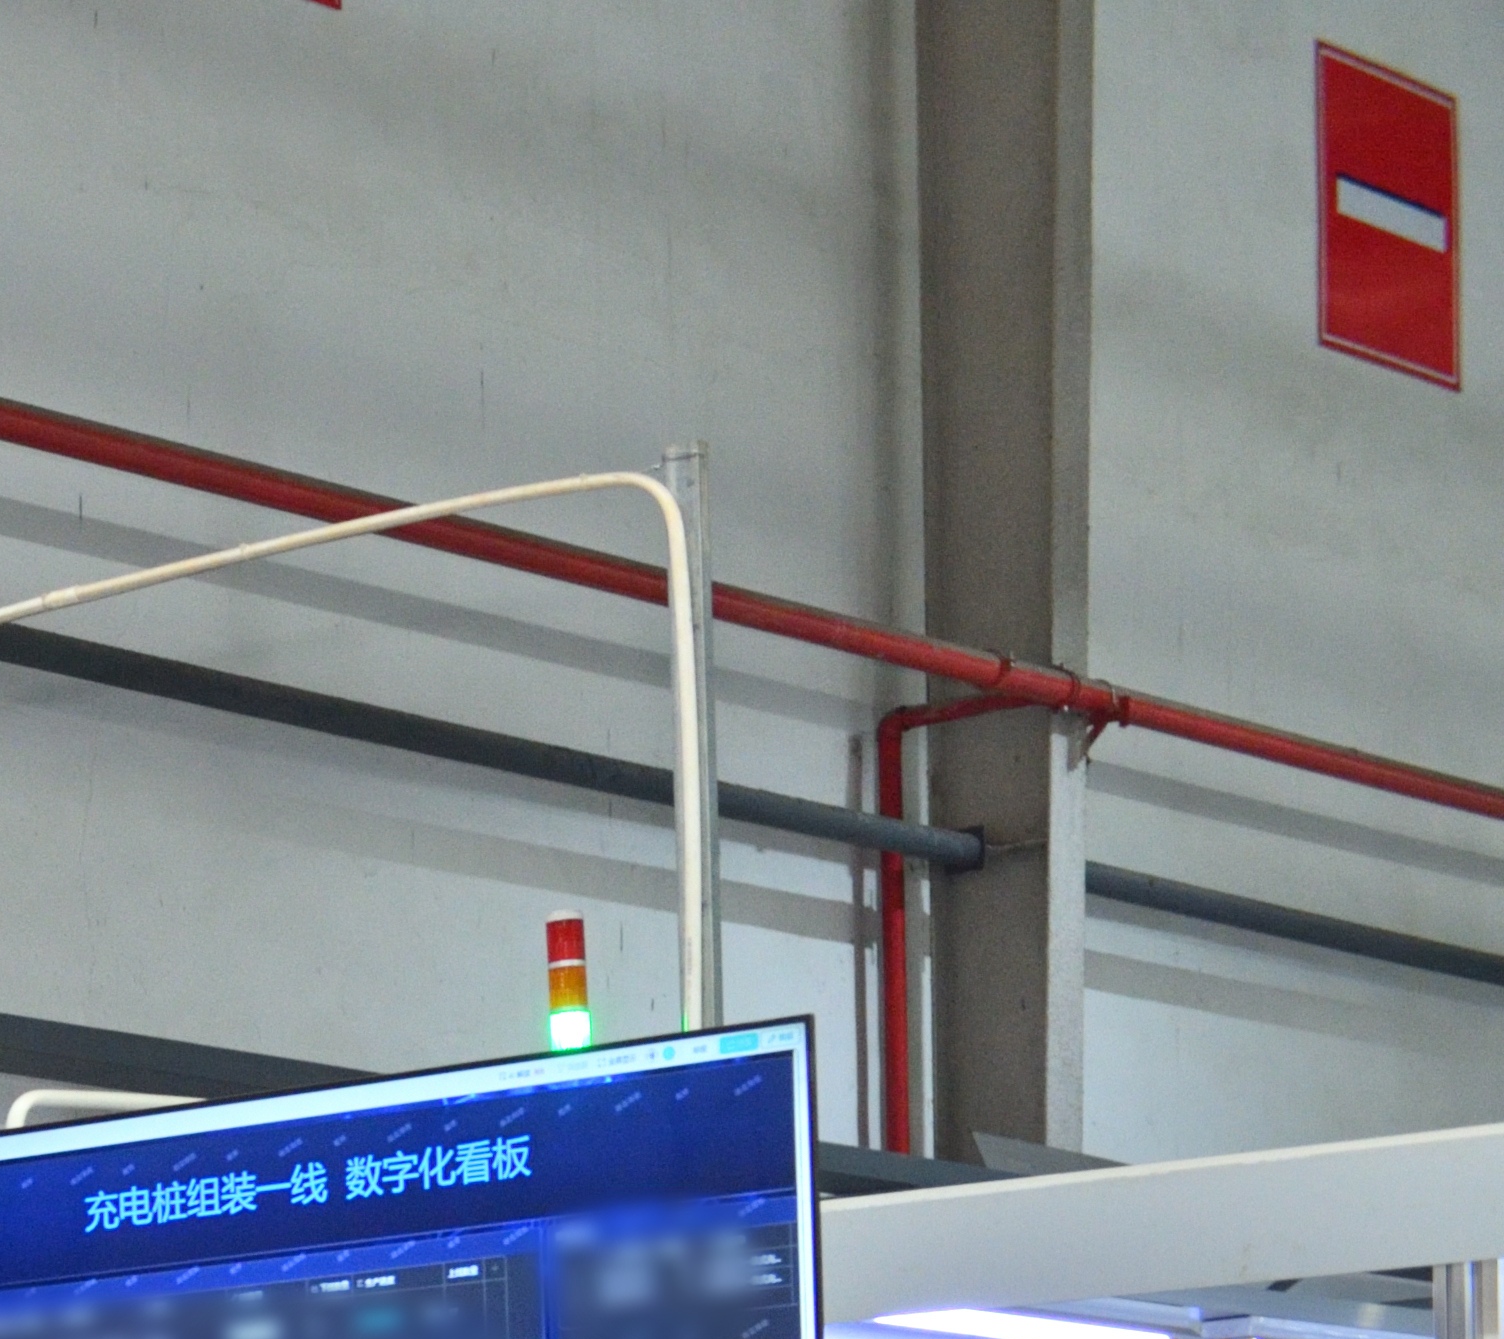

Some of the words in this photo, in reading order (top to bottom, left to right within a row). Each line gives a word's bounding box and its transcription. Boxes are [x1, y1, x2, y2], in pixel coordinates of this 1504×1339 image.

[84, 1162, 329, 1233] 充电桩组装一线
[345, 1134, 532, 1200] 数字化看板
